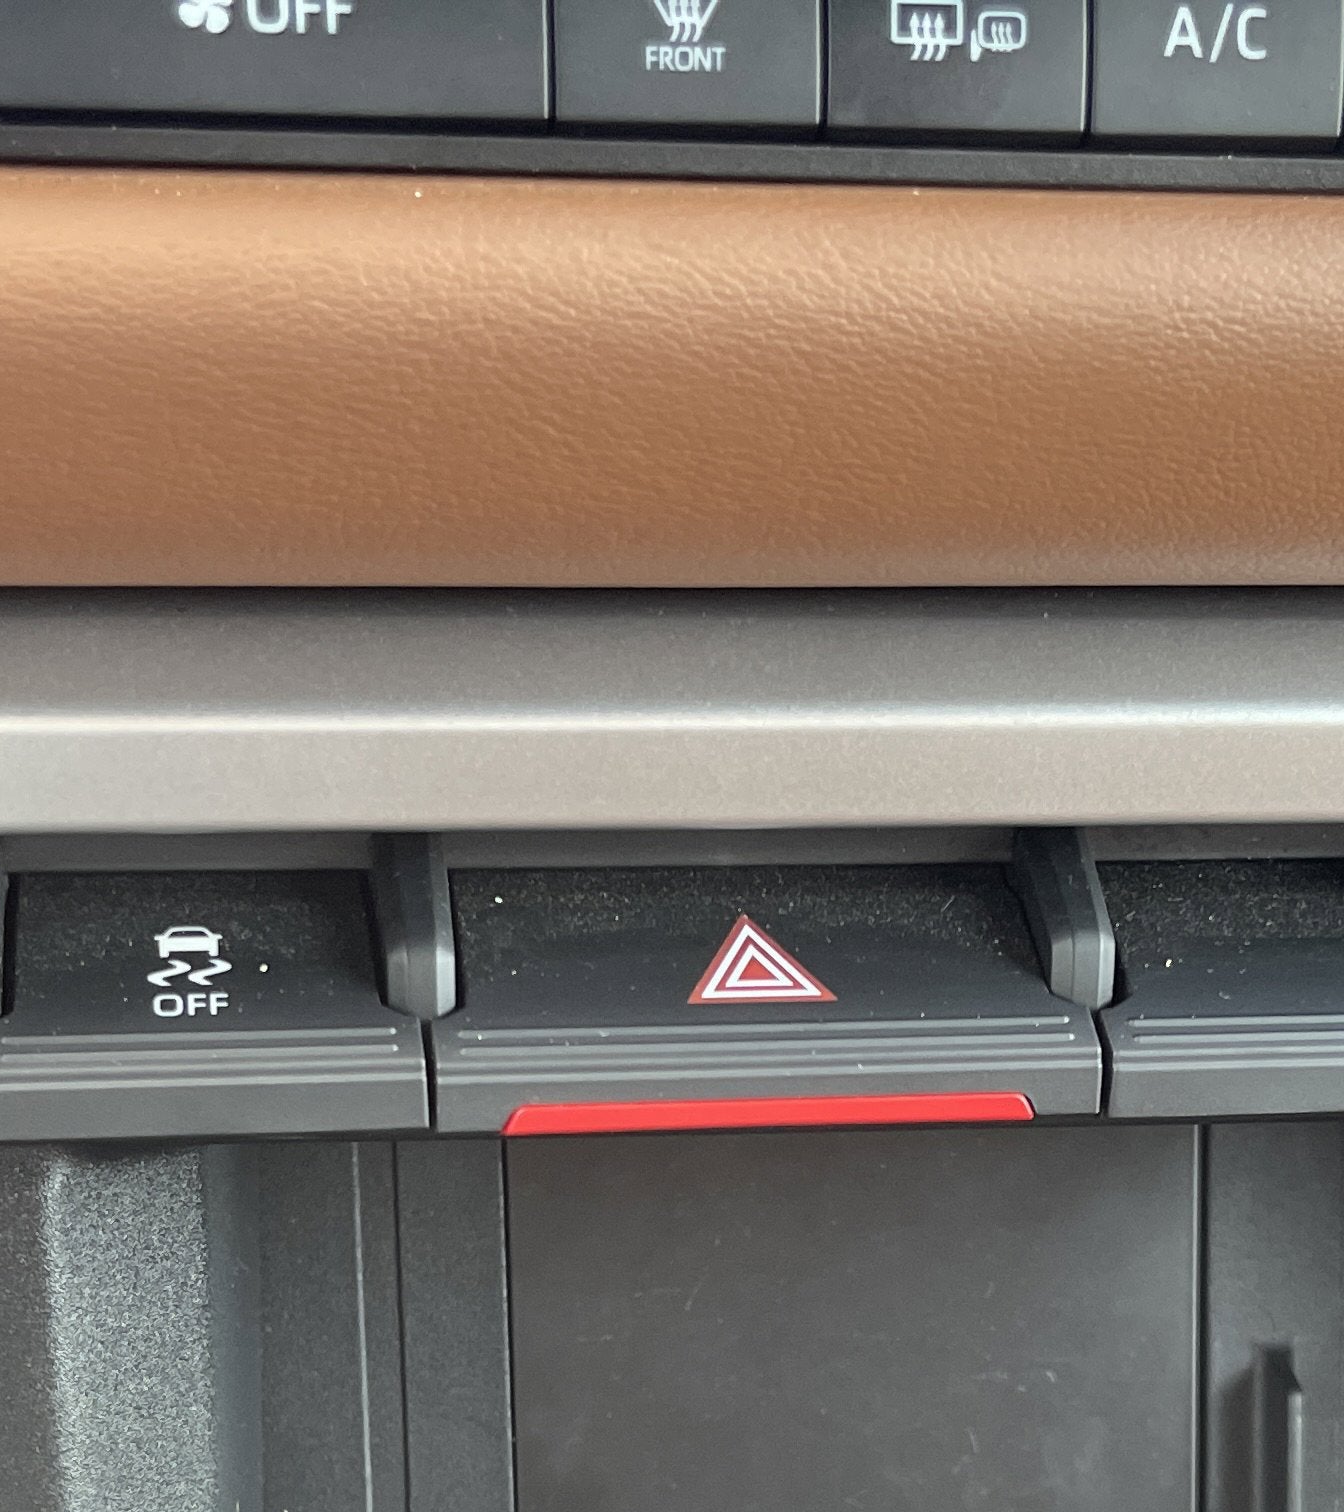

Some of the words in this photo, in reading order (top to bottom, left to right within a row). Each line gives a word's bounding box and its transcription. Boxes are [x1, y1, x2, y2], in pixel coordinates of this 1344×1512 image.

[246, 0, 352, 34] OFF
[1163, 3, 1267, 63] A/C
[645, 45, 726, 72] FRONT
[153, 991, 229, 1017] OFF
